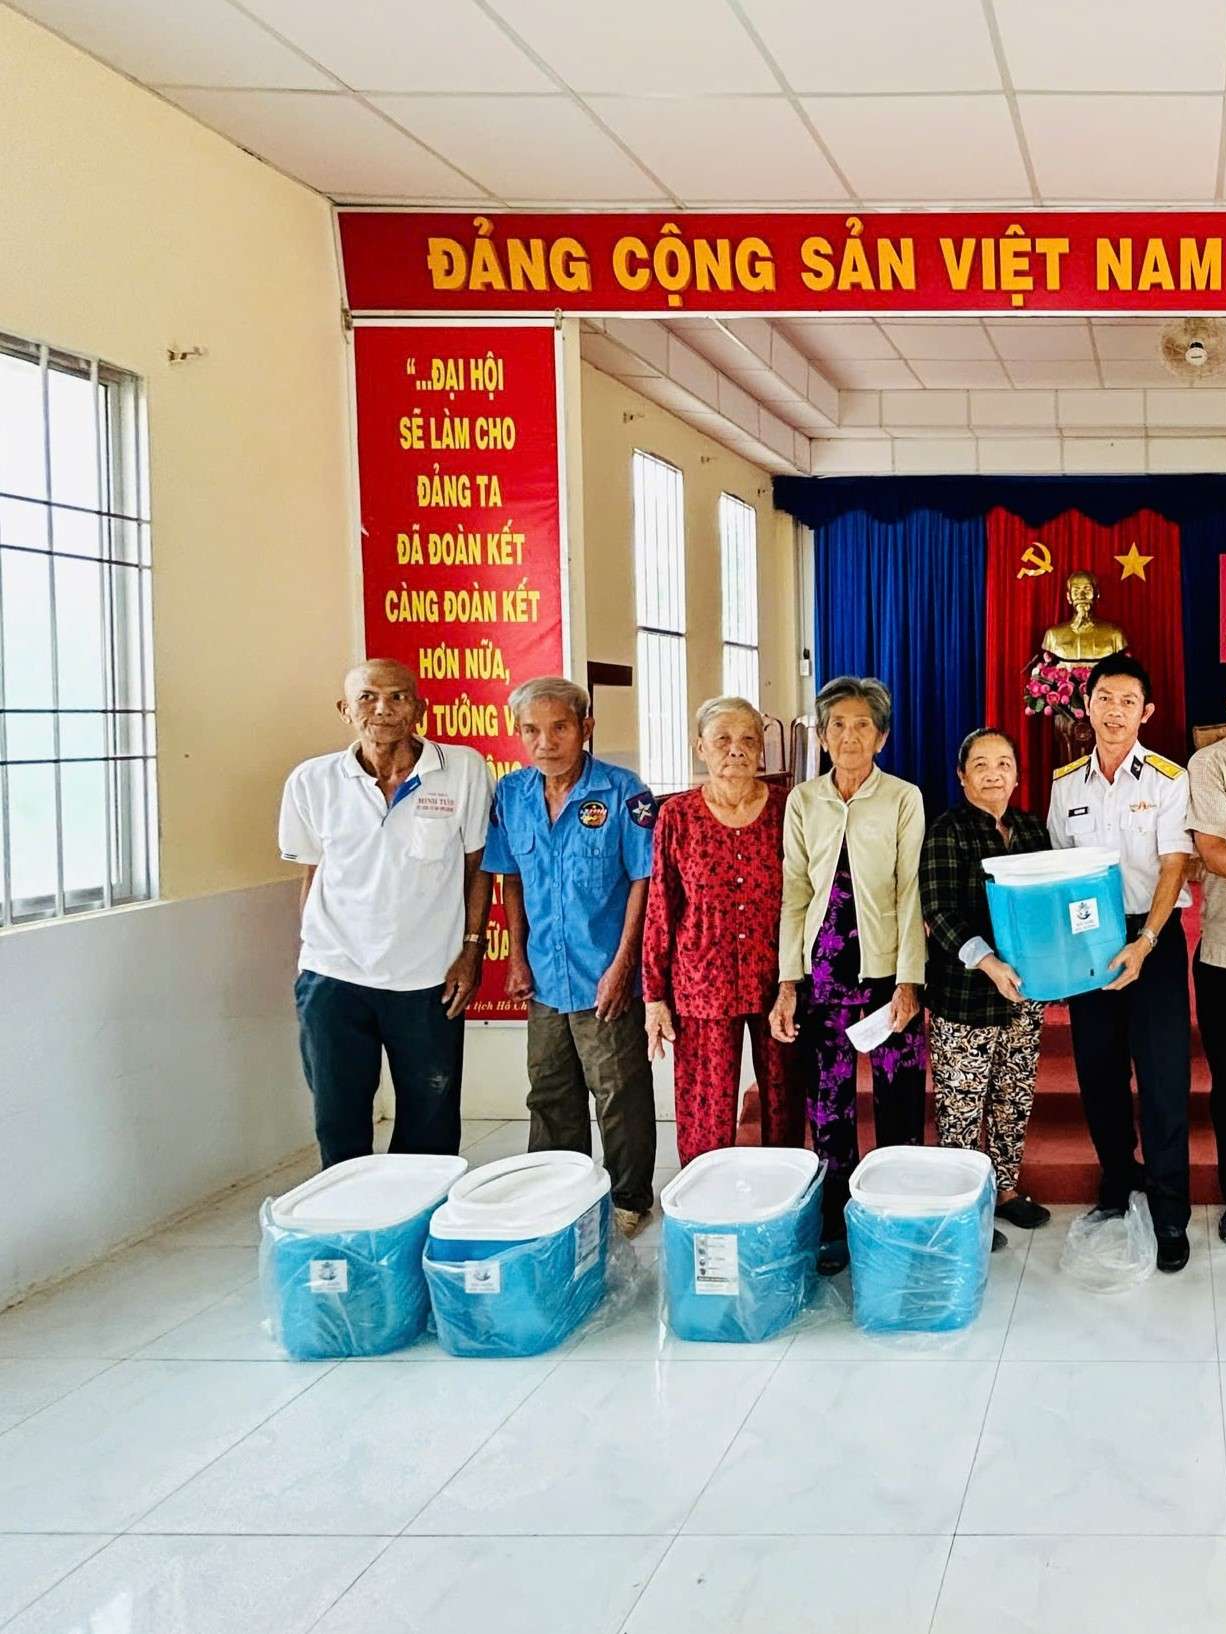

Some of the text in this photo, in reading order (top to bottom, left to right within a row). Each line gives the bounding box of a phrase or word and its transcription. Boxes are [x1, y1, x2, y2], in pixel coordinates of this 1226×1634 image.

[427, 216, 591, 292] ĐẢNG
[613, 223, 775, 307] CỘNG
[800, 216, 916, 292] SẢN
[941, 223, 1069, 306] VIỆT
[1096, 237, 1221, 292] NAM
[470, 352, 503, 400] HỘI
[400, 408, 515, 449] SẼ LÀM CHO
[417, 463, 502, 507] ĐẢNG TA
[397, 519, 526, 566] ĐÃ ĐOÀN KẾT
[385, 577, 540, 623] CÀNG ĐOÀN KẾT
[419, 639, 510, 685] HƠN NỮA,
[433, 692, 499, 737] TƯỞNG
[496, 1000, 511, 1011] Hồ
